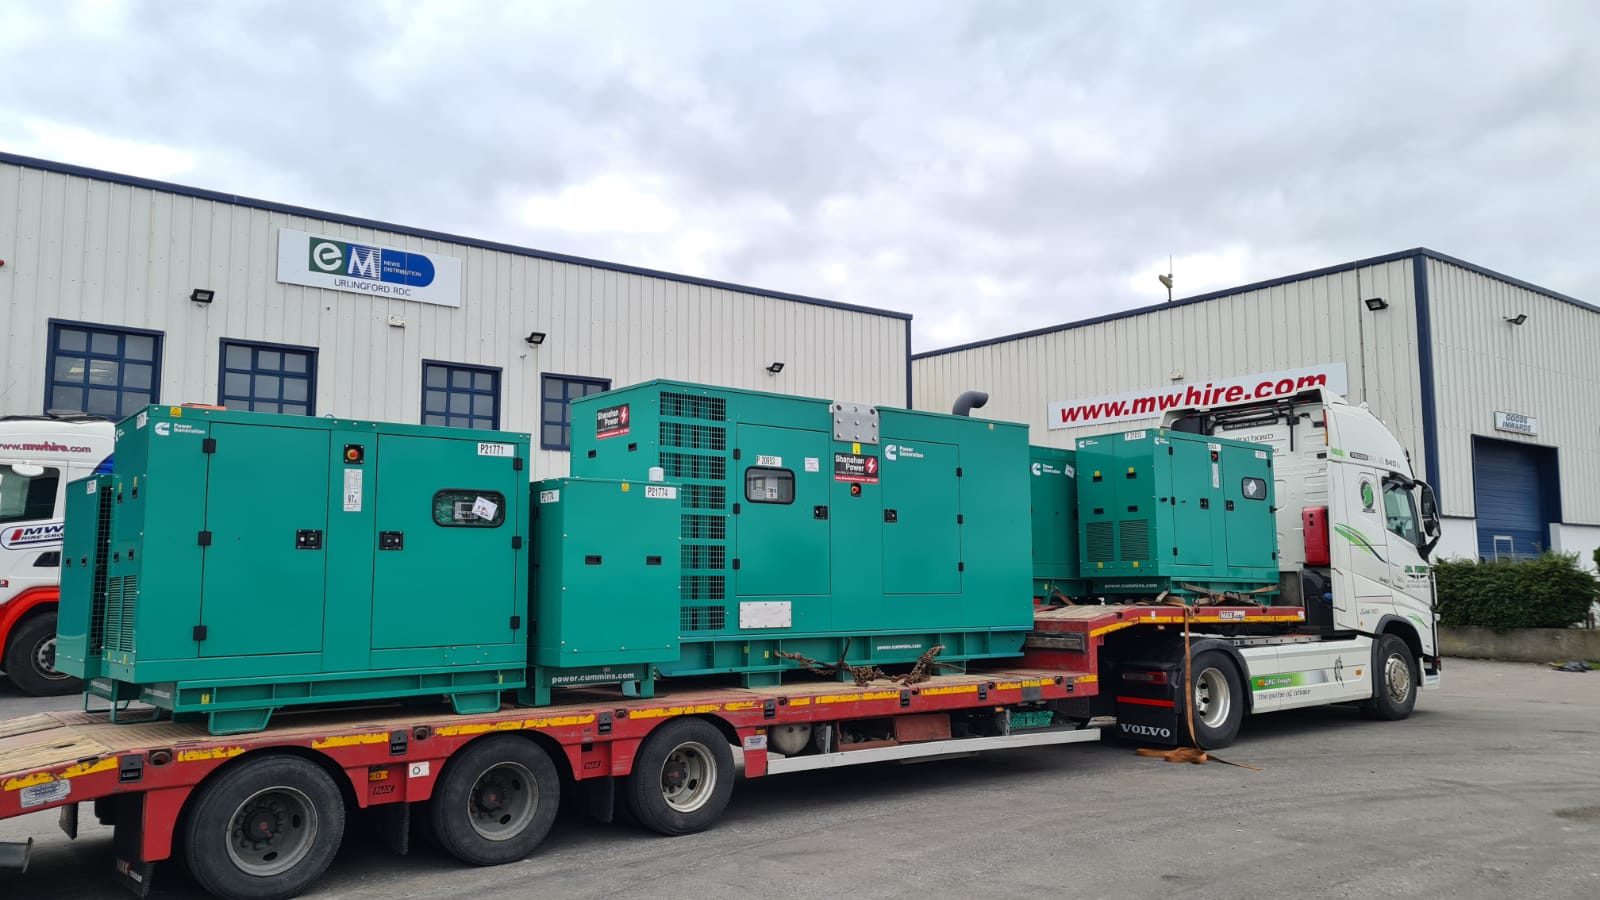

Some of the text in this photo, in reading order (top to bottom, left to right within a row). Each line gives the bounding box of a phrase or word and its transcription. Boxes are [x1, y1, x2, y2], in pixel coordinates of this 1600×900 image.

[384, 267, 421, 277] DISTRIBUTION
[334, 278, 411, 297] URLINGFORD RDC
[1060, 373, 1327, 423] www.mwhire.com
[480, 443, 504, 455] P21771
[835, 454, 865, 464] Shanahan
[845, 462, 865, 472] Power
[647, 487, 669, 497] P21774
[552, 672, 635, 684] power.cummins.com
[1120, 723, 1171, 738] VOLVO
